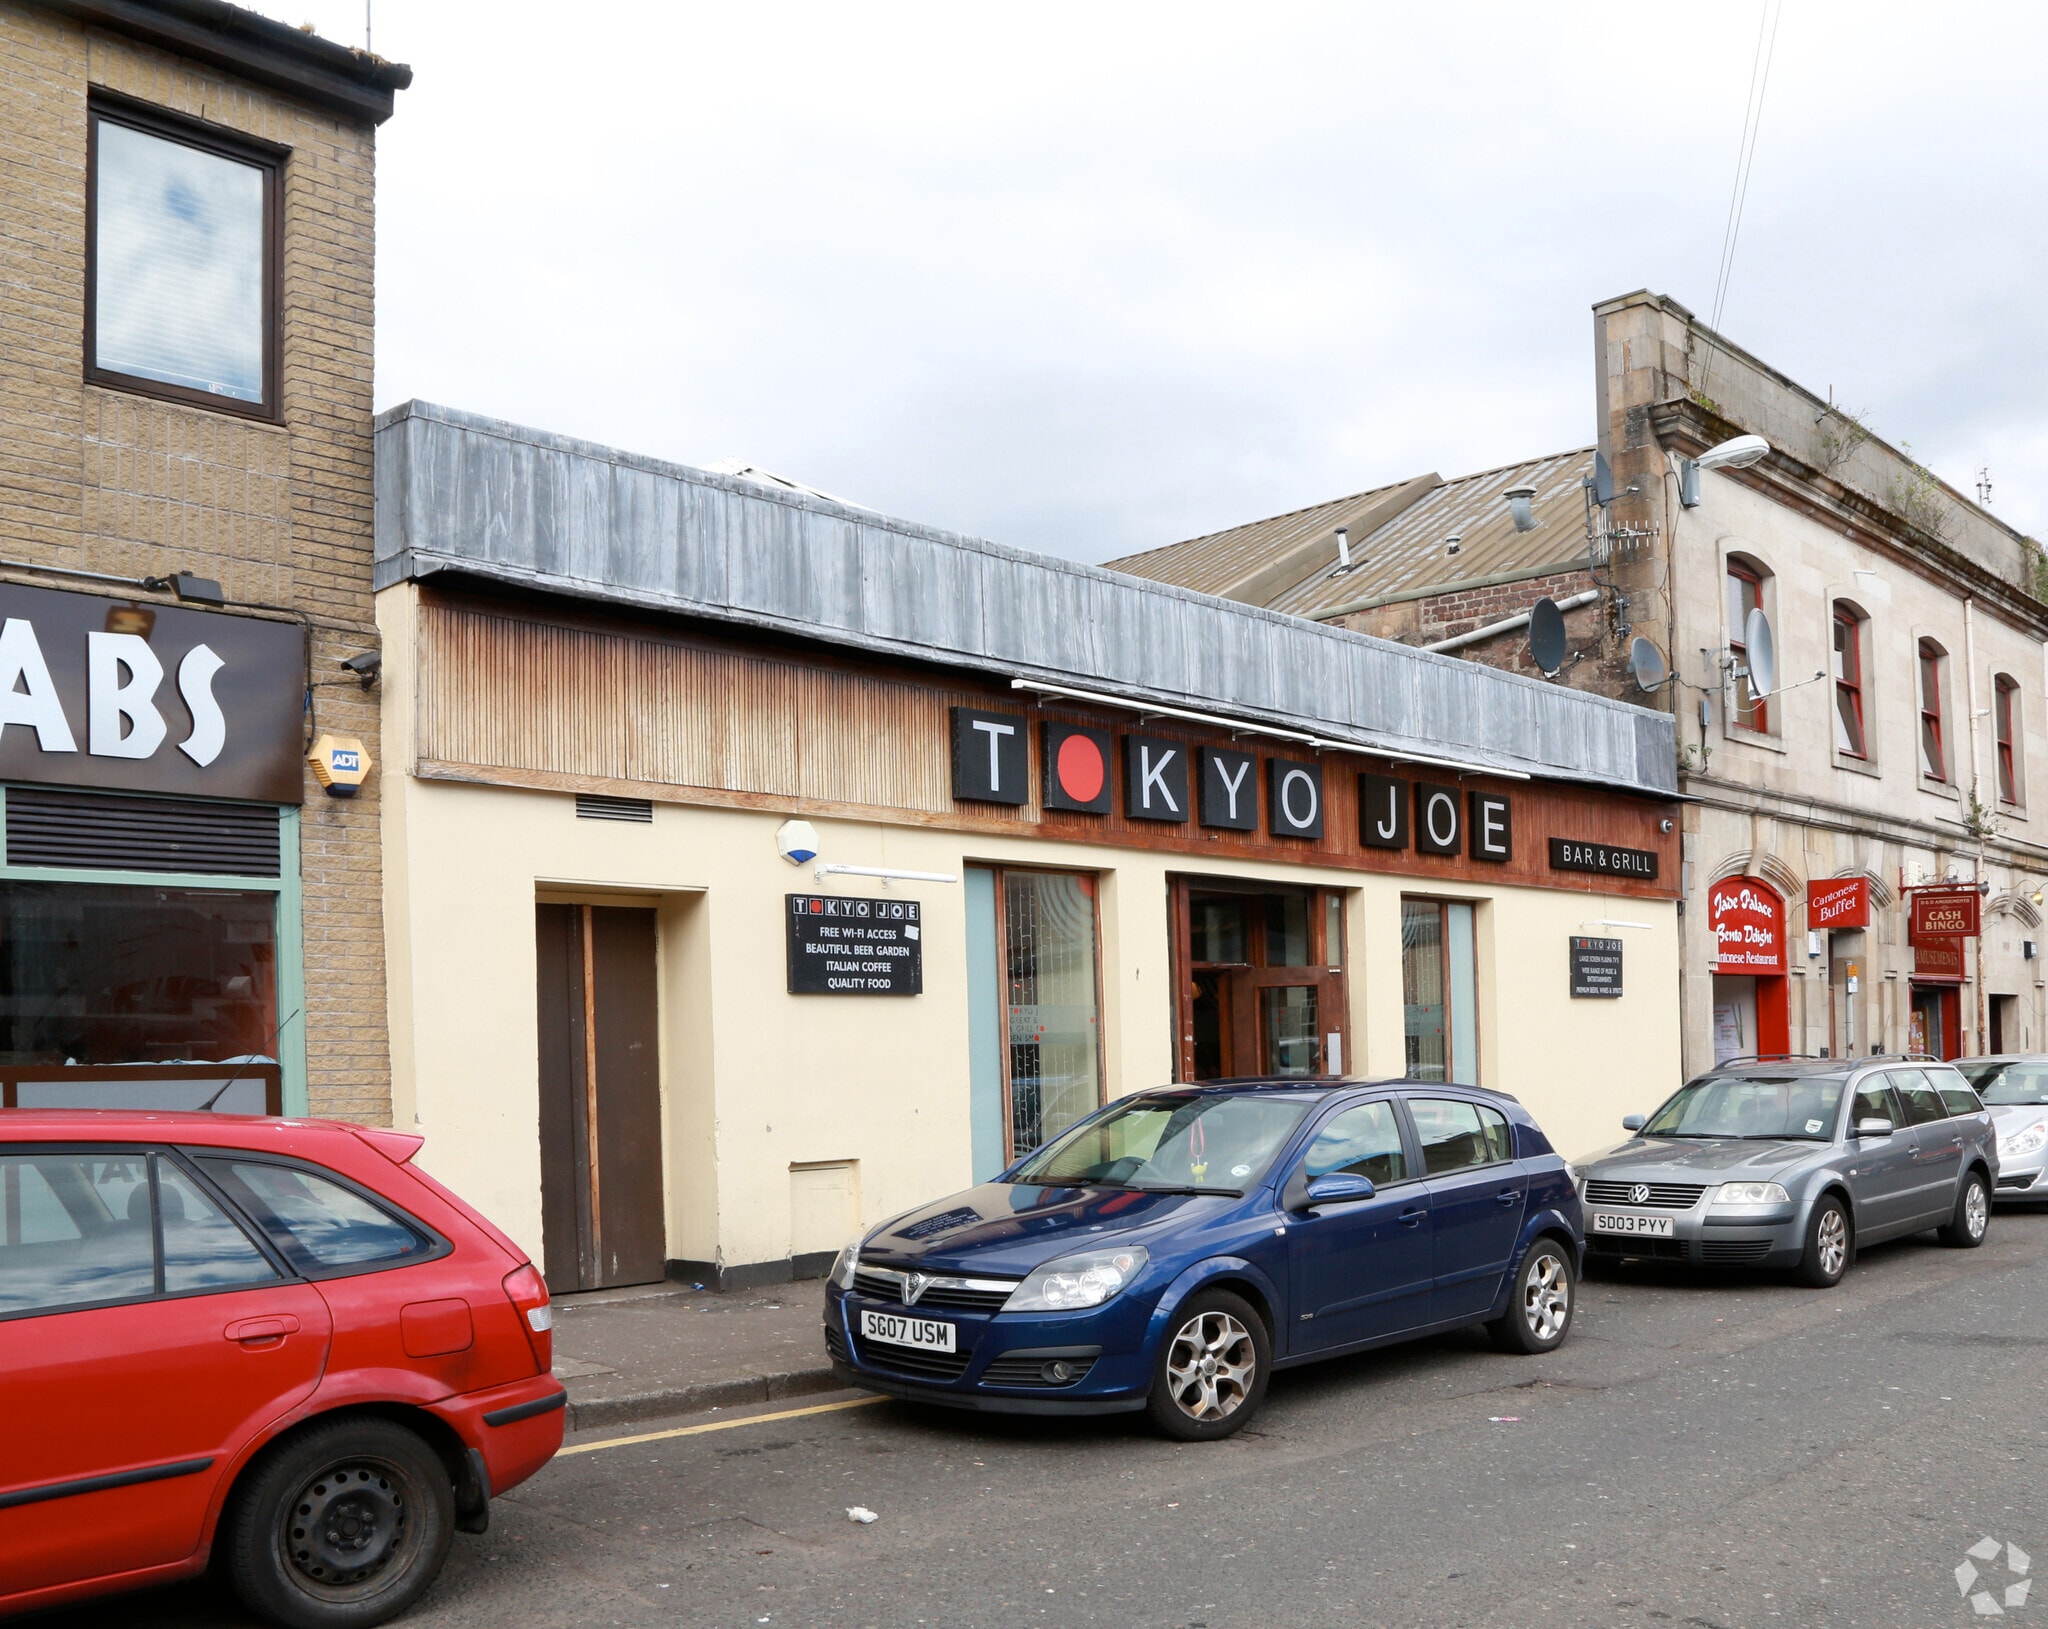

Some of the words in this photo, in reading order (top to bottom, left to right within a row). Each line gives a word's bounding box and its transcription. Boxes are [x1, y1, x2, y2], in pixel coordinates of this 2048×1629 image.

[332, 753, 360, 768] ADT
[972, 720, 1317, 829] TOKYO
[1377, 786, 1506, 854] JOE
[1563, 844, 1594, 865] BAR
[1598, 849, 1607, 867] &
[1611, 852, 1651, 873] GRILL
[1812, 882, 1859, 908] Cantonese
[795, 898, 869, 917] TOKYO
[877, 902, 918, 920] JOE
[1714, 891, 1738, 919] Jade
[1740, 888, 1773, 918] Palace
[1820, 896, 1857, 922] Buffet
[1928, 910, 1962, 921] CASH
[819, 926, 840, 938] FREE
[842, 927, 865, 939] WI-FI
[866, 929, 897, 940] ACCESS
[1925, 920, 1966, 931] BINGO
[1715, 922, 1742, 943] Bento
[1743, 924, 1773, 947] Delight
[806, 942, 852, 956] BEAUTIFUL
[854, 946, 874, 956] BEER
[876, 945, 910, 957] GARDEN
[1606, 941, 1622, 951] JOE
[1745, 951, 1778, 965] Restaurant
[826, 960, 859, 972] ITALIAN
[861, 961, 892, 973] COFFEE
[827, 977, 865, 990] QUALITY
[867, 978, 891, 989] FOOD
[1598, 1215, 1634, 1231] SD03
[1638, 1218, 1668, 1233] PYY
[867, 1314, 907, 1340] SG07
[912, 1320, 948, 1346] USM
